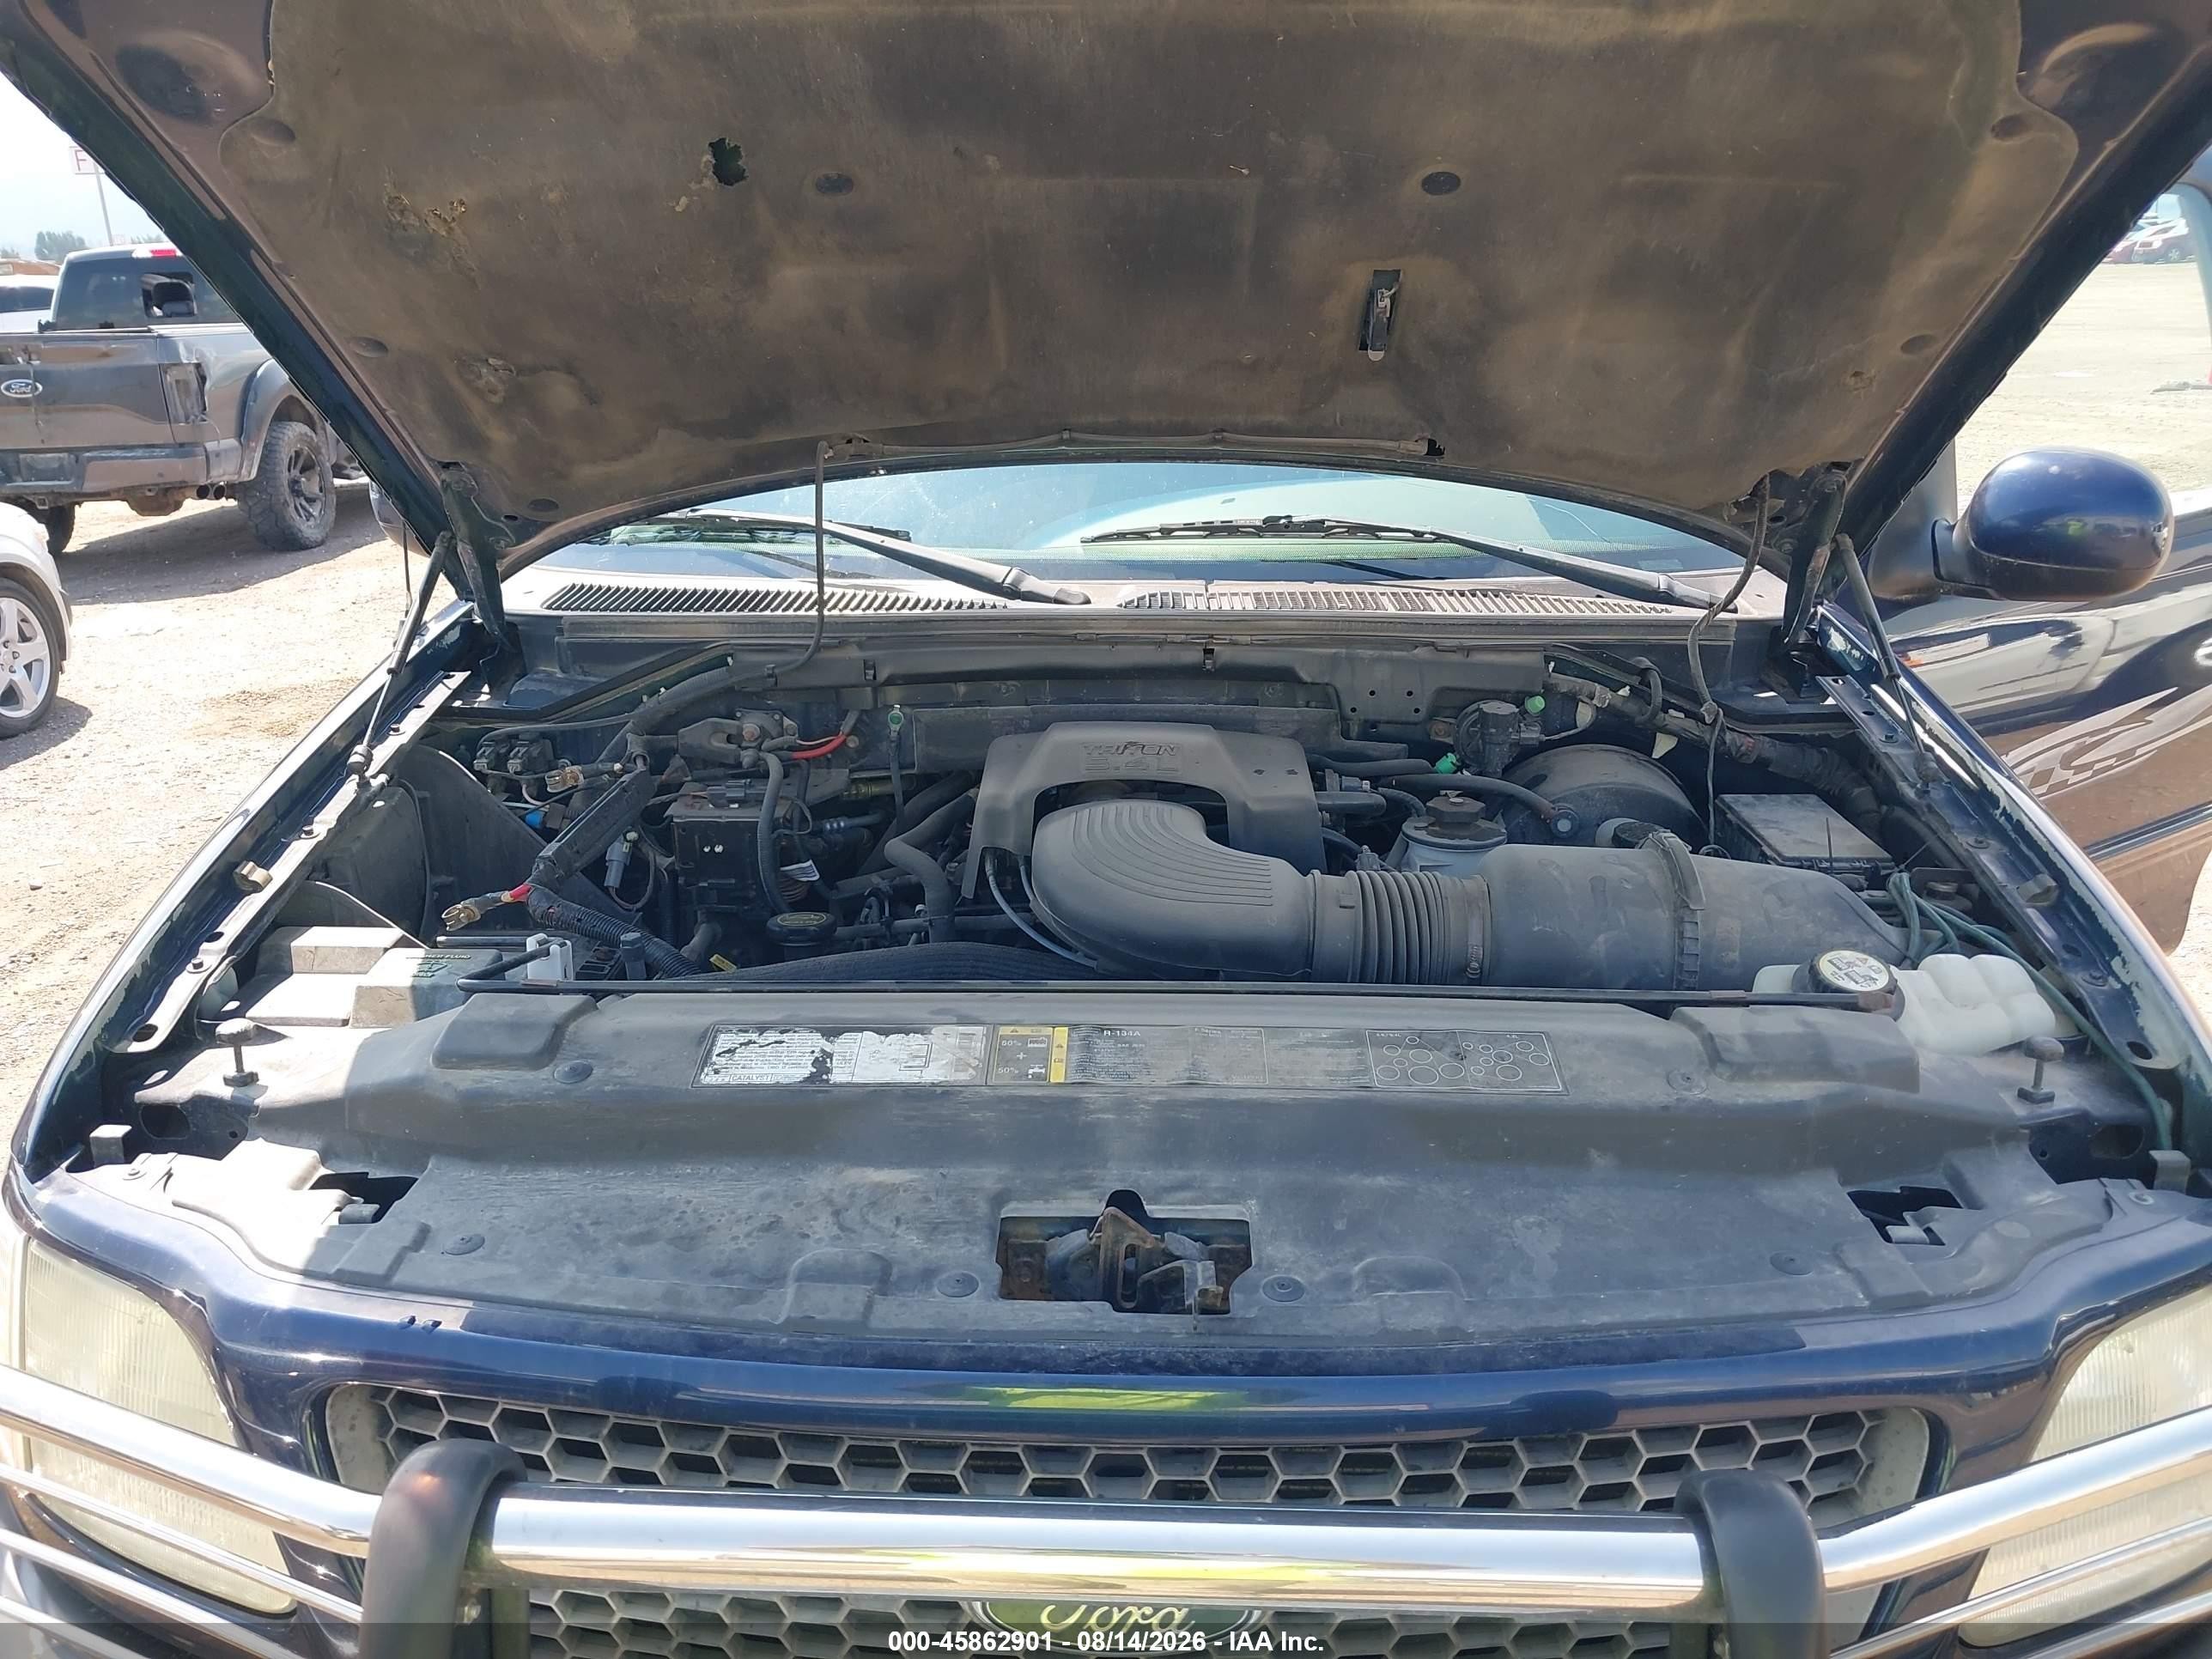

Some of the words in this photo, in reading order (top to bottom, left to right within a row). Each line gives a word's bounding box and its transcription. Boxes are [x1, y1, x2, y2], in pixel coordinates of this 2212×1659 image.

[10, 382, 32, 393] Ford
[1082, 742, 1177, 757] TRITON
[1085, 757, 1180, 772] 5.4L
